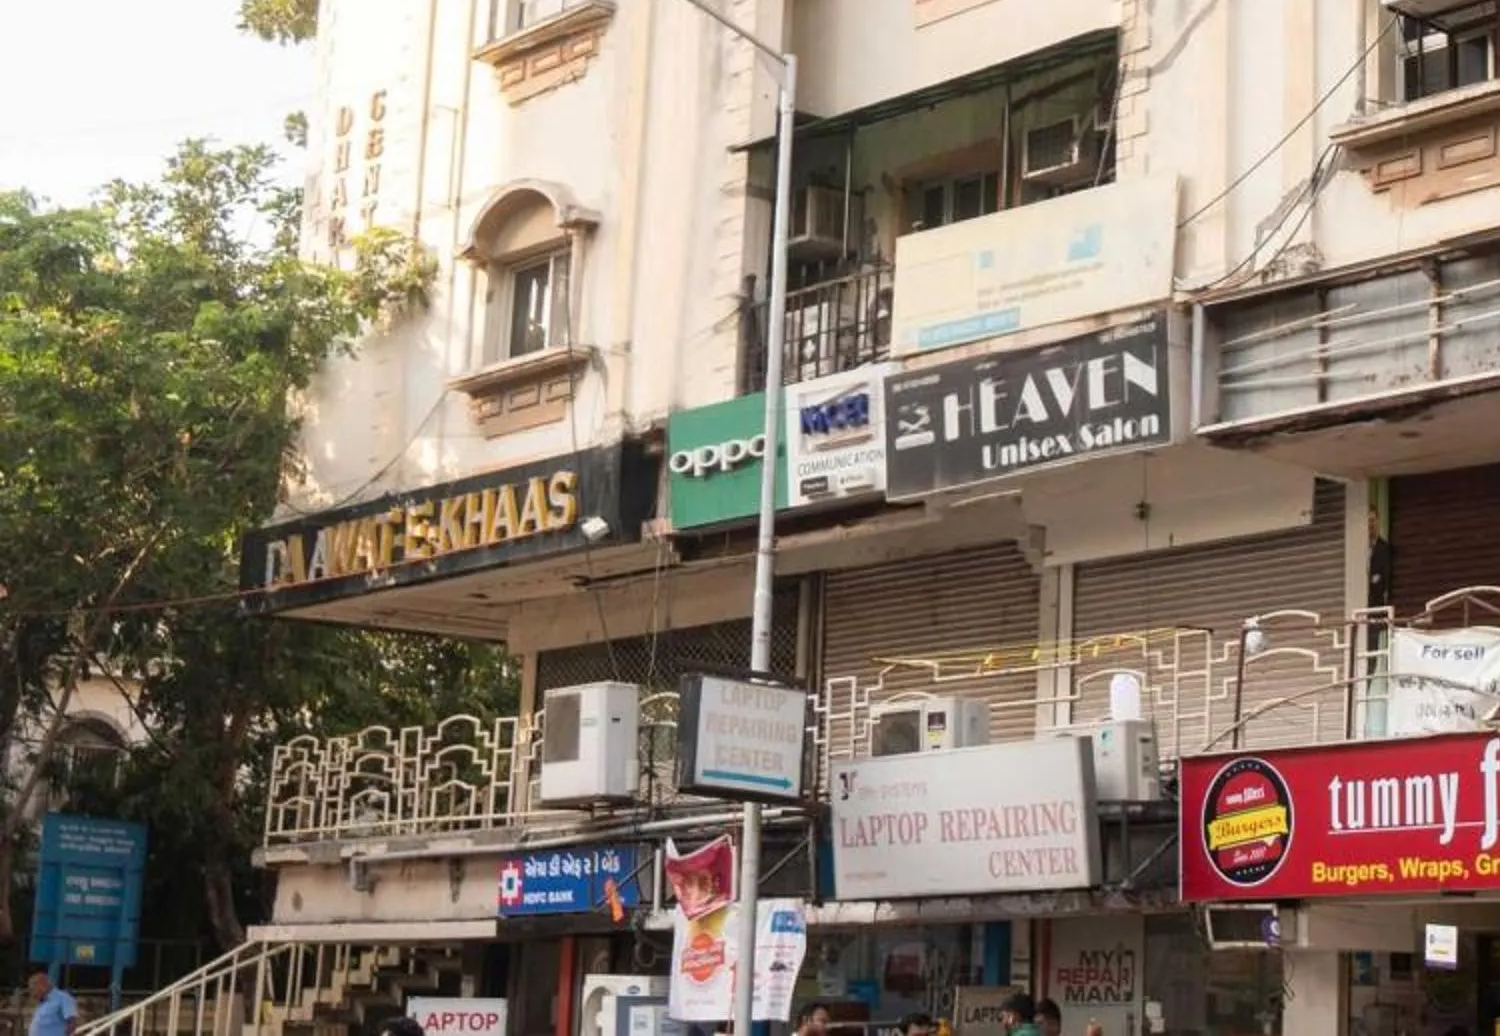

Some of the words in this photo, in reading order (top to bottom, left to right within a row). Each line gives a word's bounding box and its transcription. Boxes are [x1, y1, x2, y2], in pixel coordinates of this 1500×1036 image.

[943, 344, 1158, 442] HEAVEN
[669, 434, 767, 477] oppo
[981, 433, 1073, 470] Unisex
[1078, 413, 1159, 450] Salon
[1422, 644, 1448, 660] For
[1454, 644, 1486, 661] sell
[839, 811, 929, 849] LAPTOP
[939, 800, 1078, 844] REPAIRING
[1328, 772, 1461, 845] tummy
[987, 846, 1080, 879] CENTER
[1311, 861, 1395, 886] Burgers,
[1399, 856, 1469, 882] Wraps,
[413, 1011, 499, 1031] APTOP
